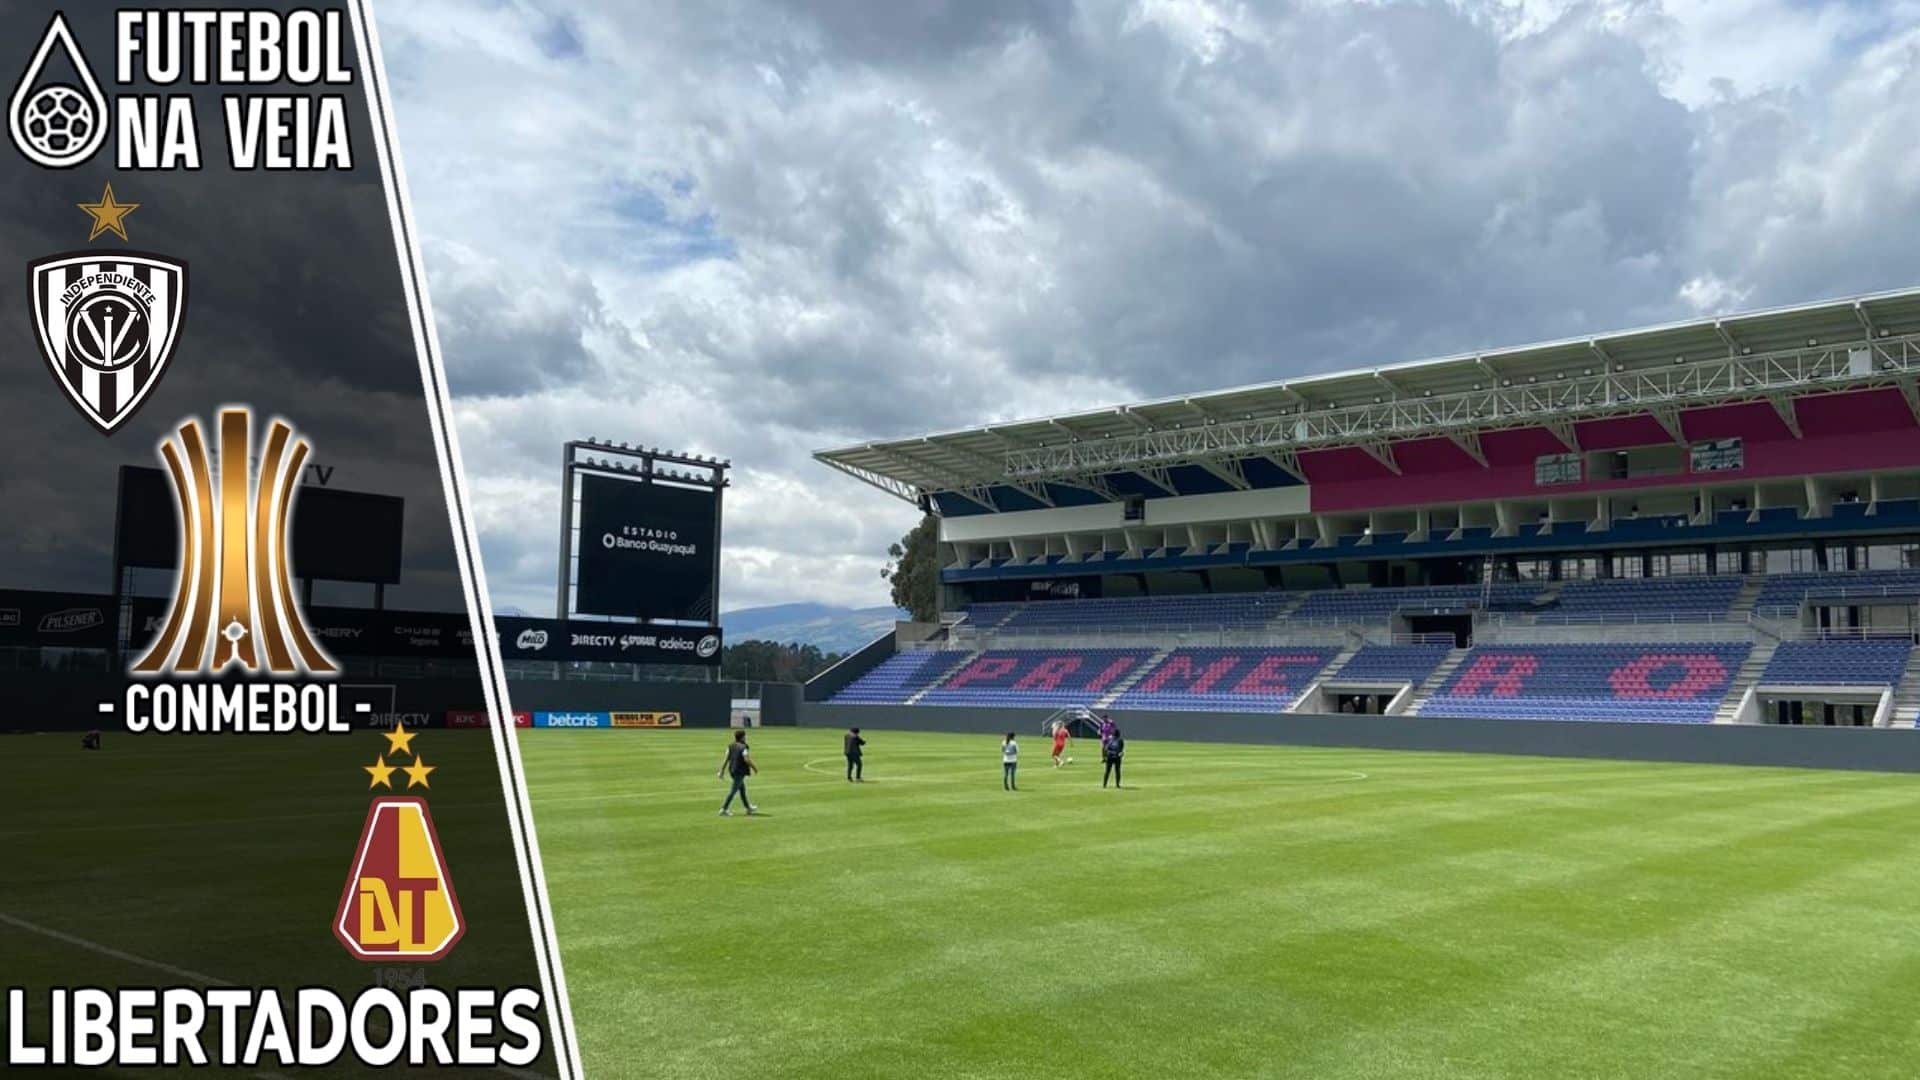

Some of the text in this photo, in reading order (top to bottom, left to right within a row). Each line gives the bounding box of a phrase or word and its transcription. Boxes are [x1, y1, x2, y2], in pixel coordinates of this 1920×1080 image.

[623, 526, 677, 540] ESTADIO
[616, 537, 696, 556] Banco Guayaquil
[47, 612, 97, 629] PILSENER
[571, 634, 616, 647] DIRECTV
[548, 713, 598, 727] betcris
